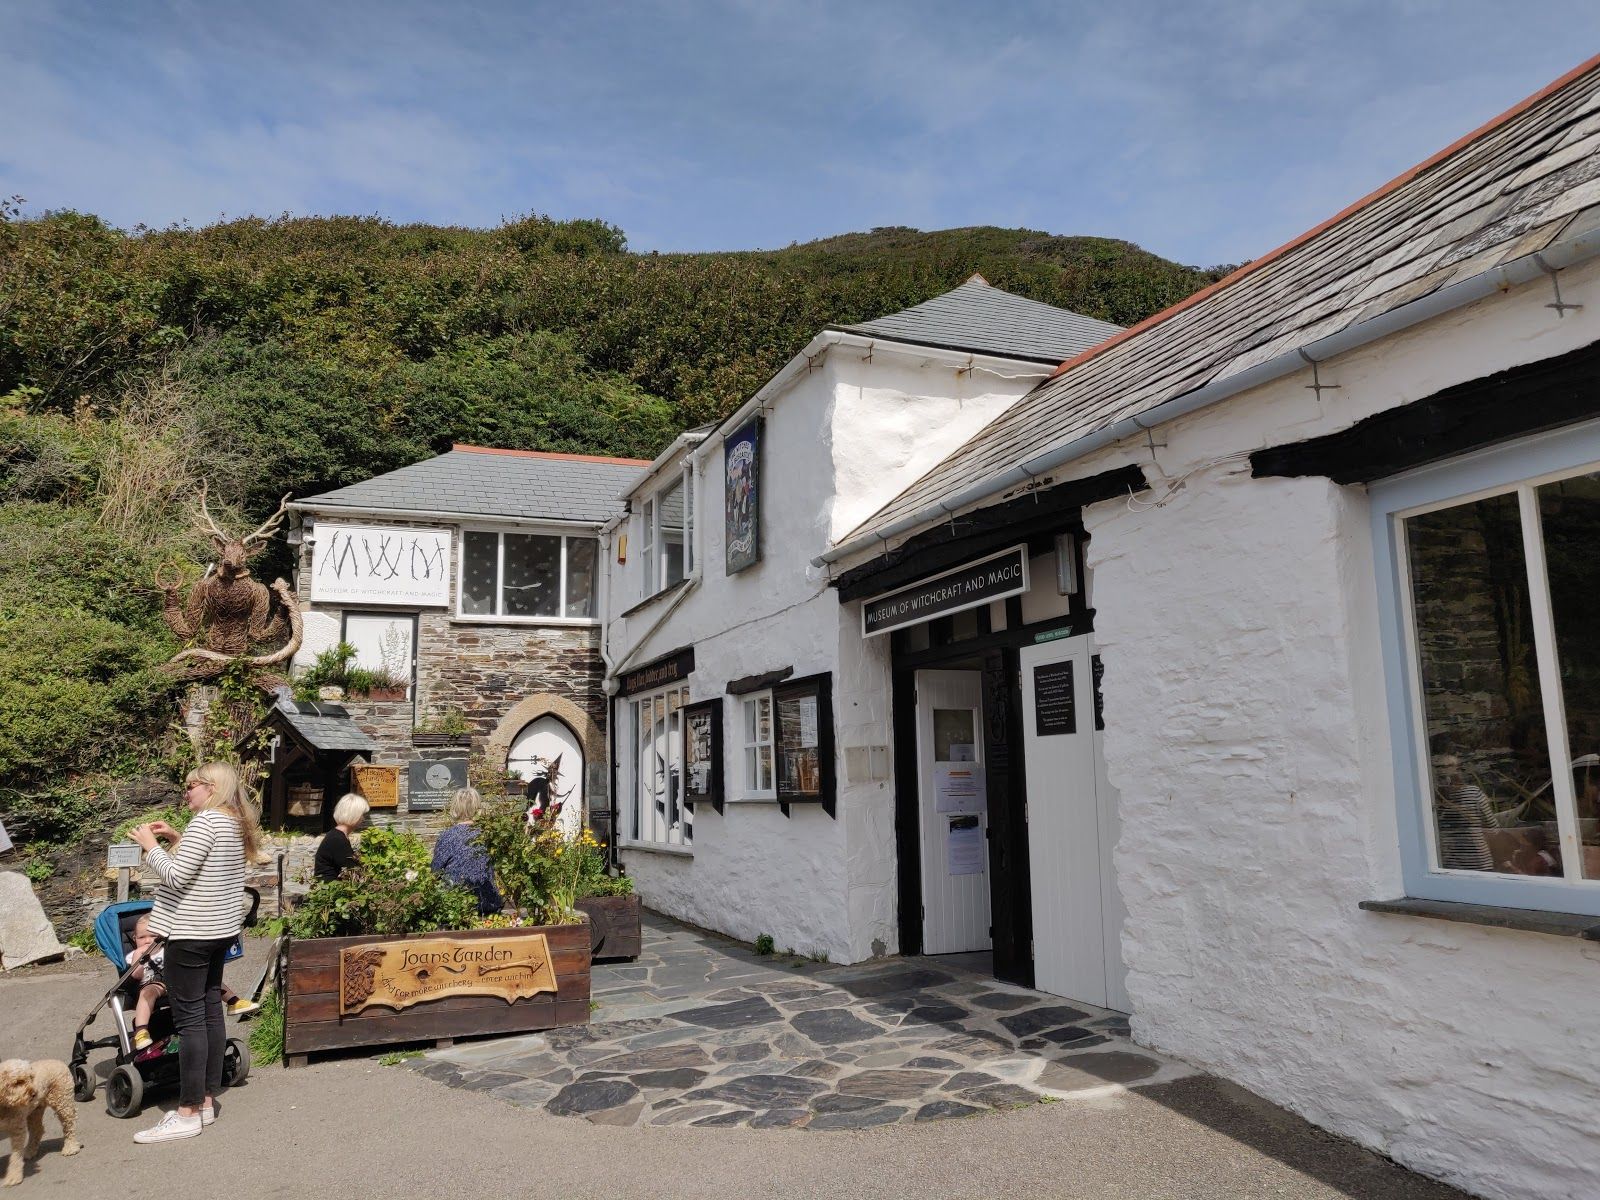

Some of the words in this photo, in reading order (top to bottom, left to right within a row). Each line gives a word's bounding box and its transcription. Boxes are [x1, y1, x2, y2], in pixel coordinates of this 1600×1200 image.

[867, 605, 898, 625] MUSEUM
[899, 600, 910, 615] OF
[911, 582, 963, 611] WITCHCRAFT
[964, 575, 985, 593] AND
[987, 563, 1021, 585] MAGIC
[399, 948, 450, 971] Joan's
[453, 945, 513, 963] Garden
[411, 985, 433, 998] more
